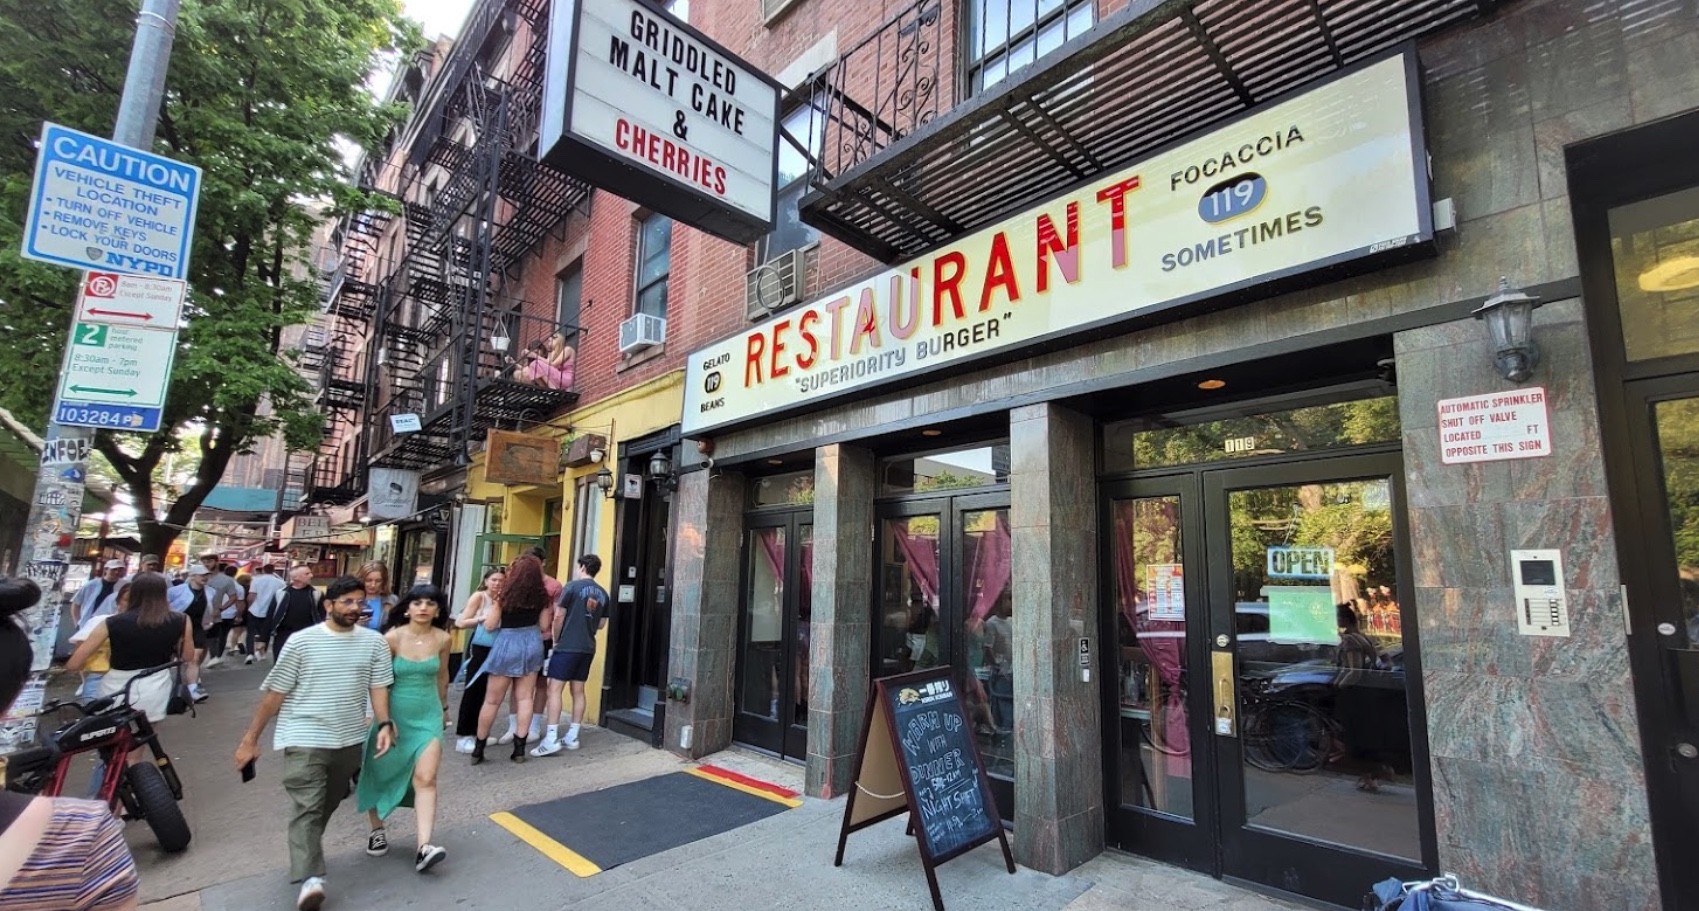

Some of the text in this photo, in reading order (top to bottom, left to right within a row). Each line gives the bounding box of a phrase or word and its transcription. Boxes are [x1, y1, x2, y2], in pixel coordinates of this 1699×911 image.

[630, 10, 736, 96] GRIDDLED
[609, 35, 745, 135] MALT CAKE
[672, 110, 688, 141] &
[53, 136, 191, 192] CAUTION
[615, 118, 727, 195] CHERRIES
[1170, 125, 1305, 191] FOCACCIA
[54, 166, 182, 209] VEHICLE THEFT
[77, 187, 158, 216] LOCATION
[1209, 180, 1255, 216] 119
[53, 211, 147, 241] REMOVE KEYS
[56, 197, 177, 235] TURN OFF VEHICLE
[51, 225, 178, 262] LOCK YOUR DOORS
[1161, 206, 1324, 272] SOMETIMES
[105, 251, 173, 277] NYPD
[744, 175, 1141, 389] RESTAURANT
[81, 324, 100, 345] 2
[72, 363, 141, 378] Except Sunday
[74, 353, 109, 364] 8:30am
[119, 357, 138, 367] 7pm
[703, 352, 731, 371] GELATO
[707, 374, 720, 391] 119
[60, 407, 120, 425] 103284
[700, 397, 725, 413] BEANS
[1440, 393, 1543, 414] AUTOMATIC SPRINKLER
[1441, 411, 1518, 428] SHUT OFF VALVE
[1443, 424, 1539, 443] LOCATED FT
[1226, 438, 1254, 452] 119
[1445, 440, 1542, 458] OPPOSITE THIS SIGN
[1272, 550, 1330, 574] OPEN
[902, 711, 963, 757] WARM UP
[926, 734, 948, 754] WITH
[909, 748, 965, 785] DINNER
